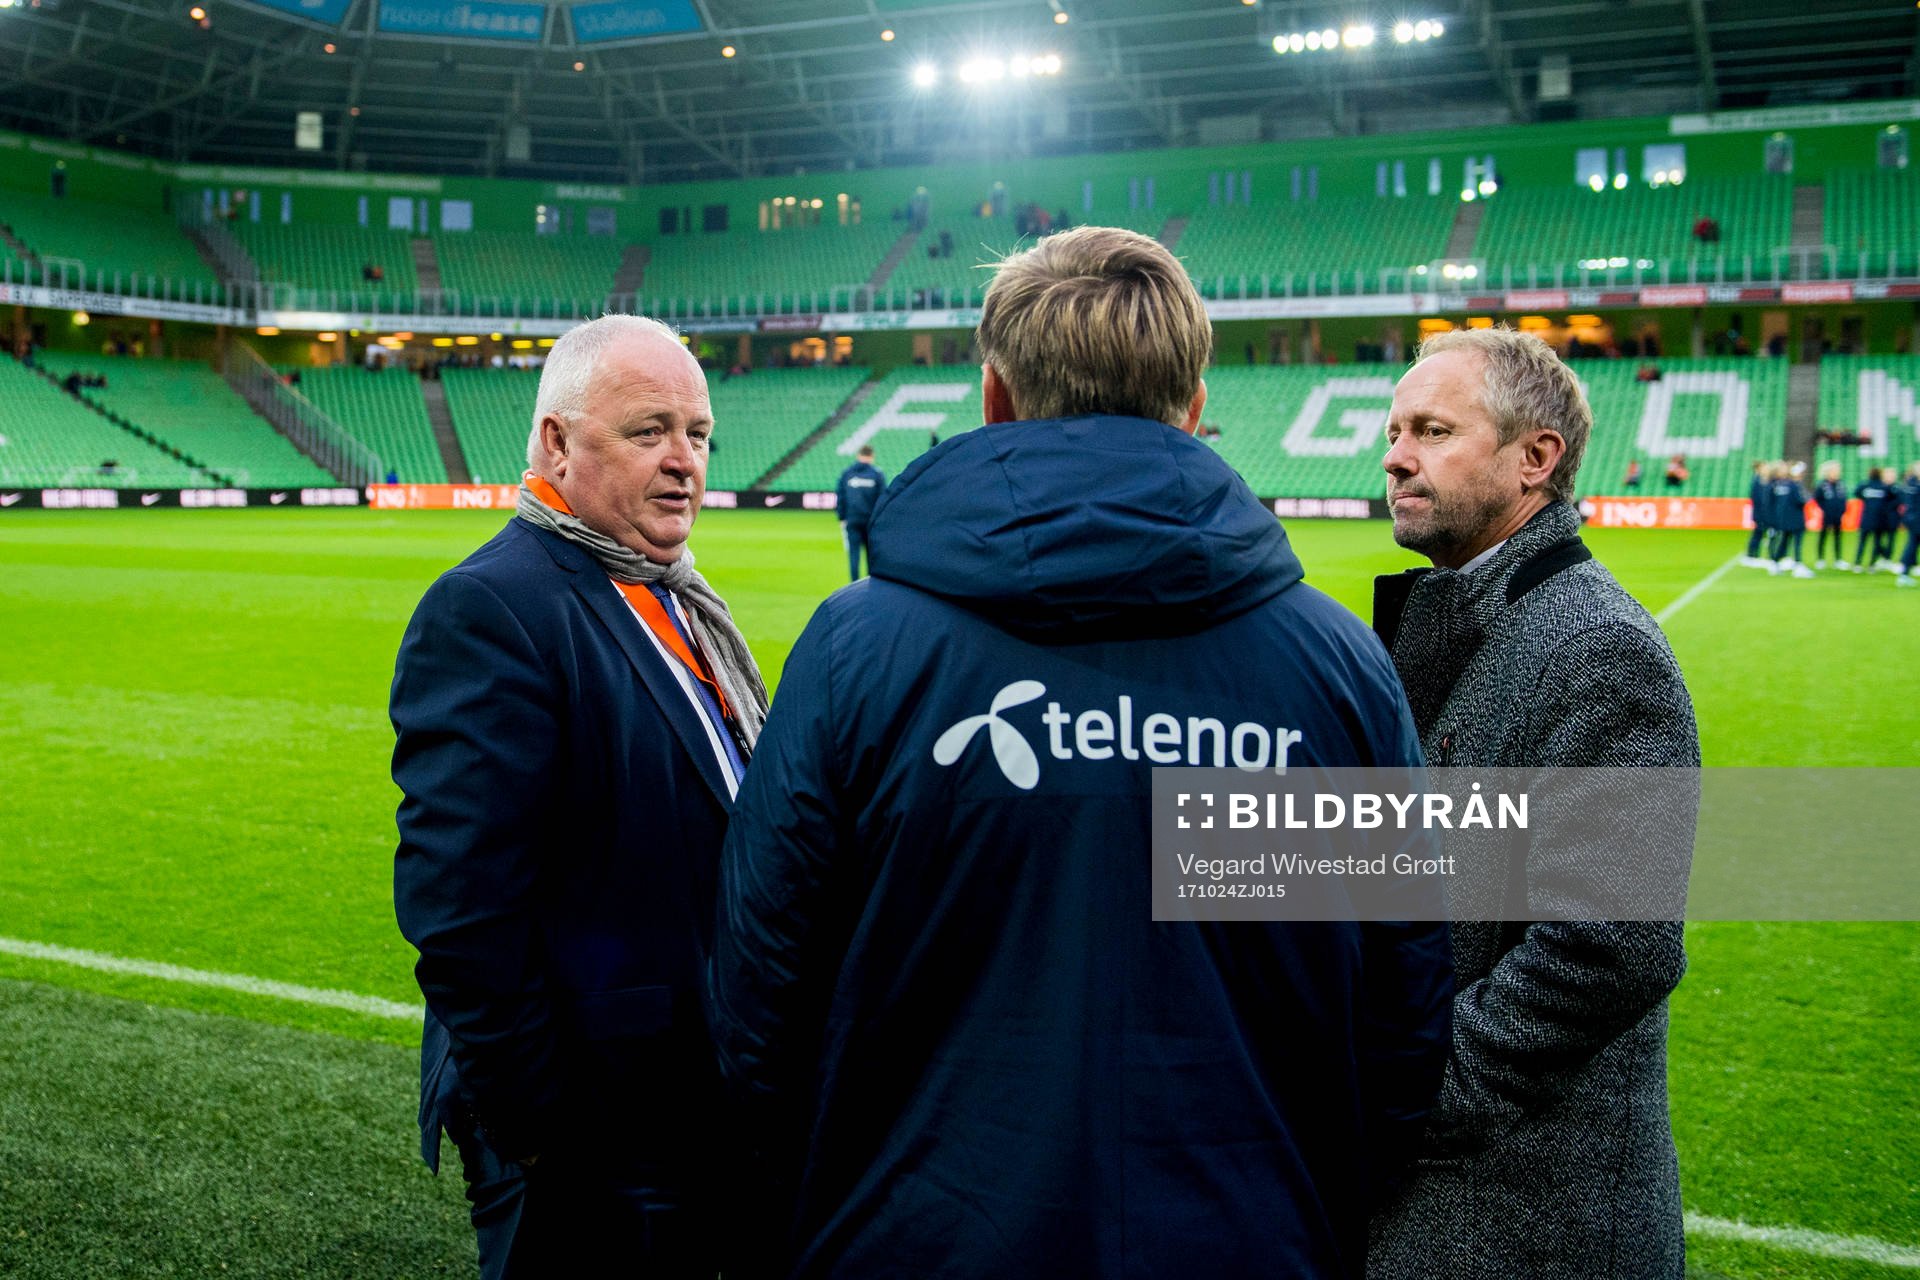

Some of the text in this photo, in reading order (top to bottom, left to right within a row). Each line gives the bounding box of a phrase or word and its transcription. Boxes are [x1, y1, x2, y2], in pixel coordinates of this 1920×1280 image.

[452, 488, 493, 508] ING
[1602, 502, 1658, 527] ING
[1042, 695, 1302, 776] telenor
